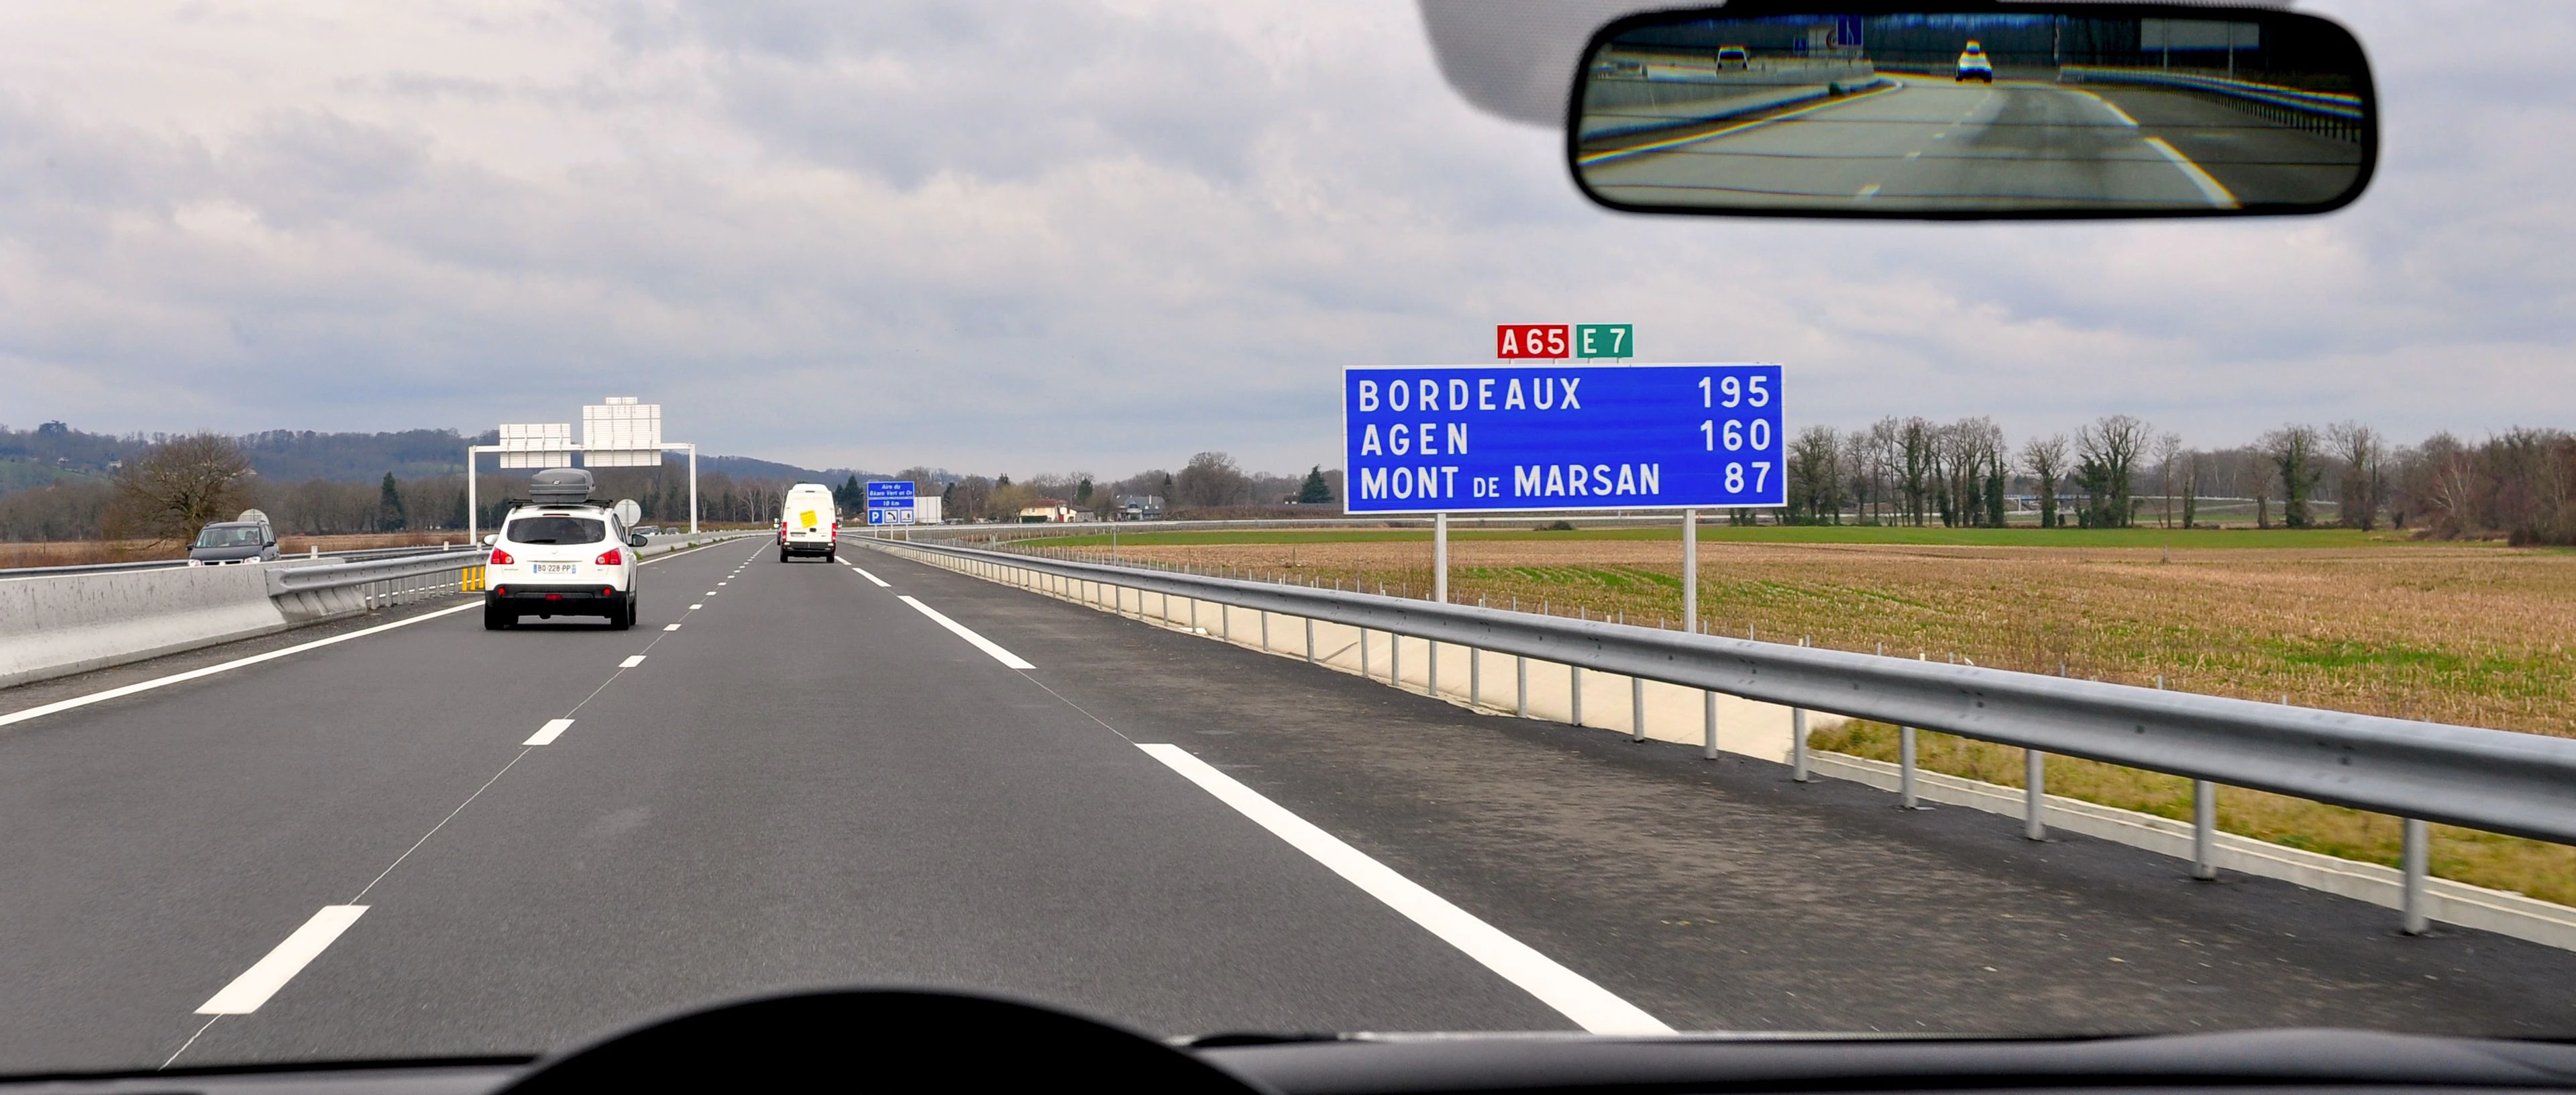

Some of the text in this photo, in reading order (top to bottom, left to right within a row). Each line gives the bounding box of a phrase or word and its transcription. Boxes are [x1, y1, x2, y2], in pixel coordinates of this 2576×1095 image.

[1359, 376, 1769, 412] BORDEAUX 195
[1360, 418, 1770, 456] AGEN 160
[1361, 461, 1771, 500] MONT DE MARSAN 87
